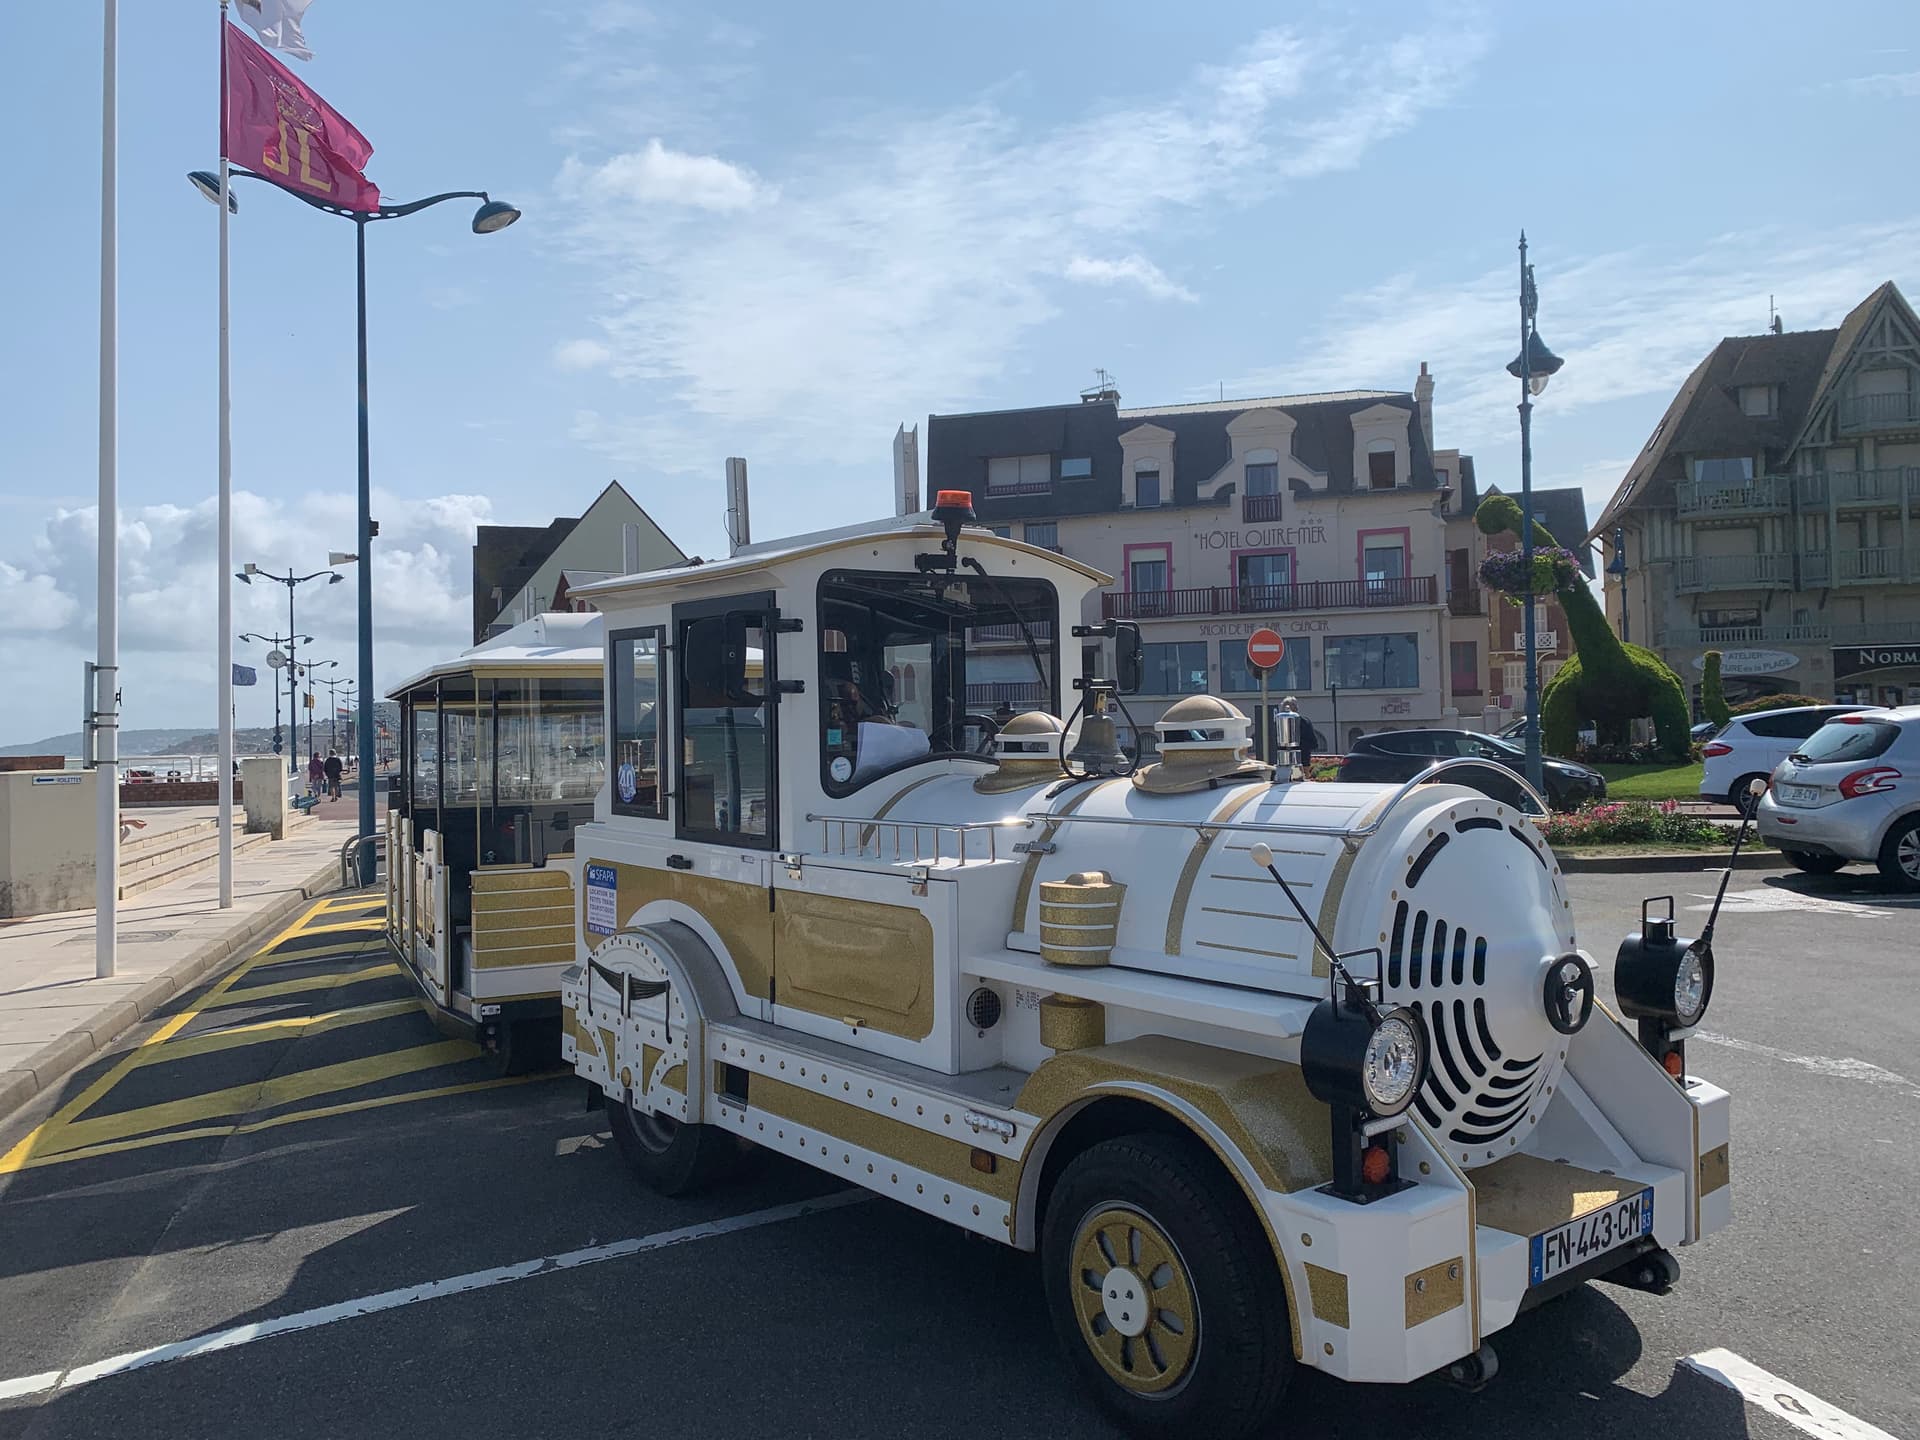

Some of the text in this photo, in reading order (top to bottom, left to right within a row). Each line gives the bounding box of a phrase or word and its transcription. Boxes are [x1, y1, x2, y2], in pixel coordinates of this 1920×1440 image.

[1200, 530, 1242, 550] HÔTEL
[1200, 624, 1226, 636] SALON
[1728, 652, 1762, 660] ATELIER
[1859, 649, 1920, 665] NORM
[596, 868, 615, 883] SFAPA
[1545, 1199, 1641, 1274] FN-443-CM
[1533, 1266, 1541, 1278] F
